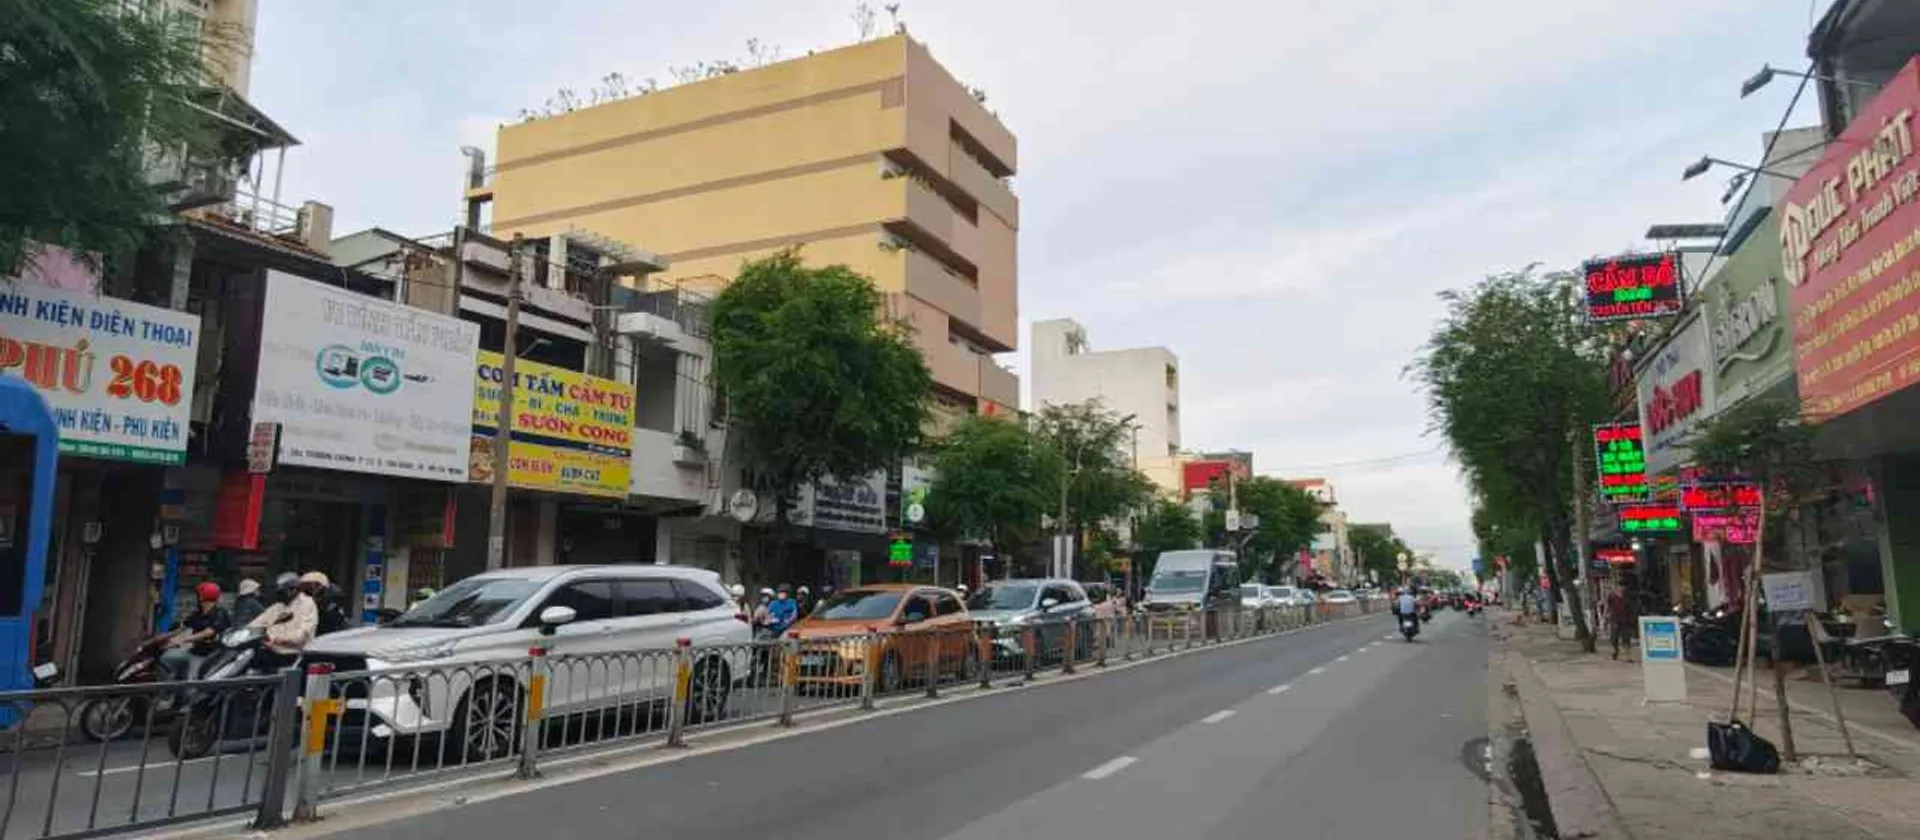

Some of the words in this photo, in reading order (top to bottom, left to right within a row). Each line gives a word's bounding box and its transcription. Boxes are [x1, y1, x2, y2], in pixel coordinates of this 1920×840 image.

[1848, 108, 1914, 204] PHÁT
[36, 299, 84, 330] KIỆN
[90, 309, 135, 338] ĐIỆN
[142, 321, 192, 349] THOẠI
[106, 354, 182, 407] 268
[525, 371, 564, 398] TẤM
